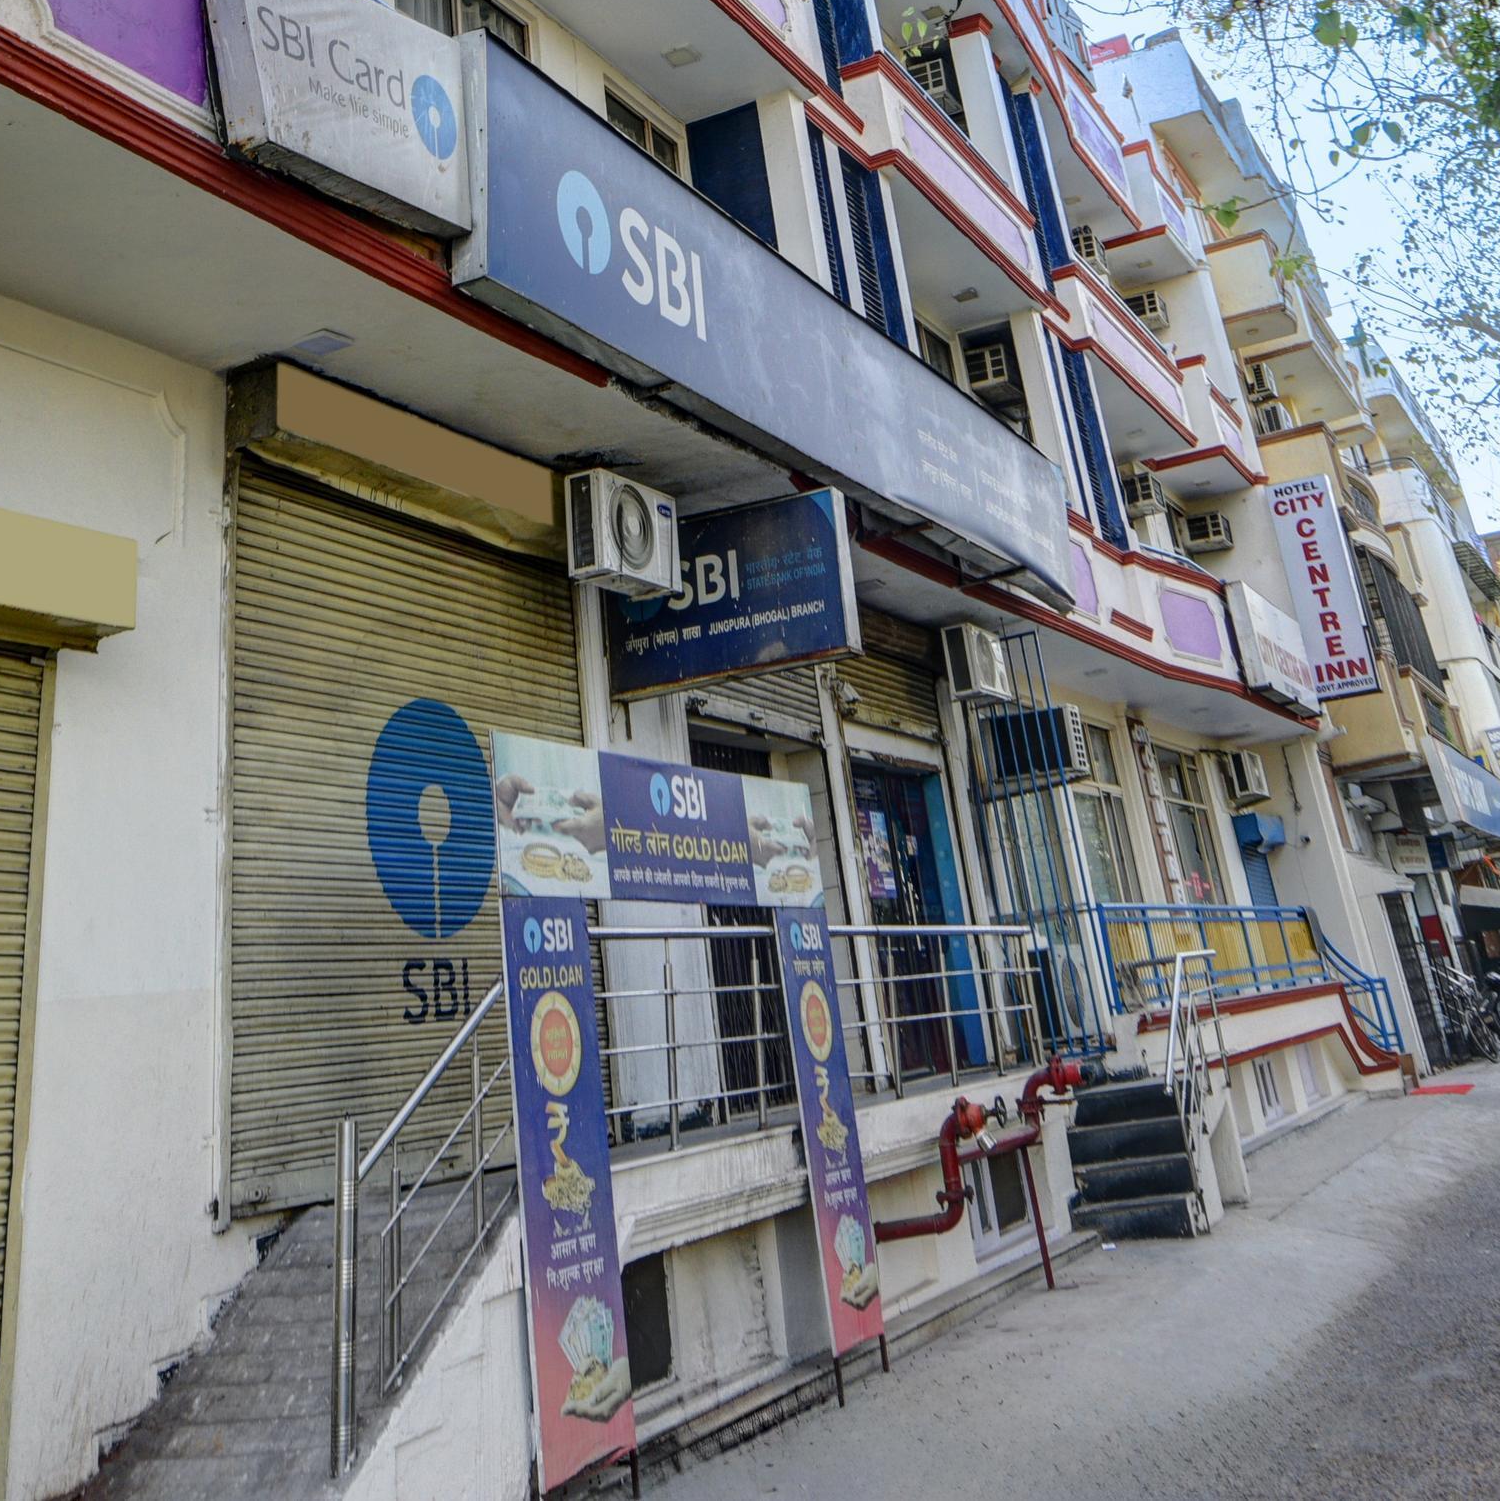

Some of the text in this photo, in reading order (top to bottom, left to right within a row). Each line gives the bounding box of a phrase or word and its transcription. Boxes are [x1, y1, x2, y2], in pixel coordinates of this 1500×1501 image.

[257, 6, 406, 110] SBI Card
[308, 76, 347, 108] Make
[372, 109, 410, 139] simple
[619, 207, 707, 343] SBI
[1273, 480, 1320, 498] HOTEL
[1273, 492, 1325, 516] CITY
[746, 562, 826, 591] STATE BANK OF INDIA
[1296, 518, 1346, 657] CENTRE
[682, 625, 701, 641] शाखा
[708, 599, 825, 636] JUNGPURA (BHOGAL) BRANCH
[1315, 657, 1369, 683] INN
[671, 774, 707, 821] SBI
[610, 818, 749, 864] गोल्ड लोन GOLD LOAN
[542, 917, 574, 952] SBI
[802, 923, 824, 951] SBI
[403, 957, 470, 1024] SBI
[519, 965, 584, 990] GOLD LOAN
[550, 1238, 577, 1260] आसान
